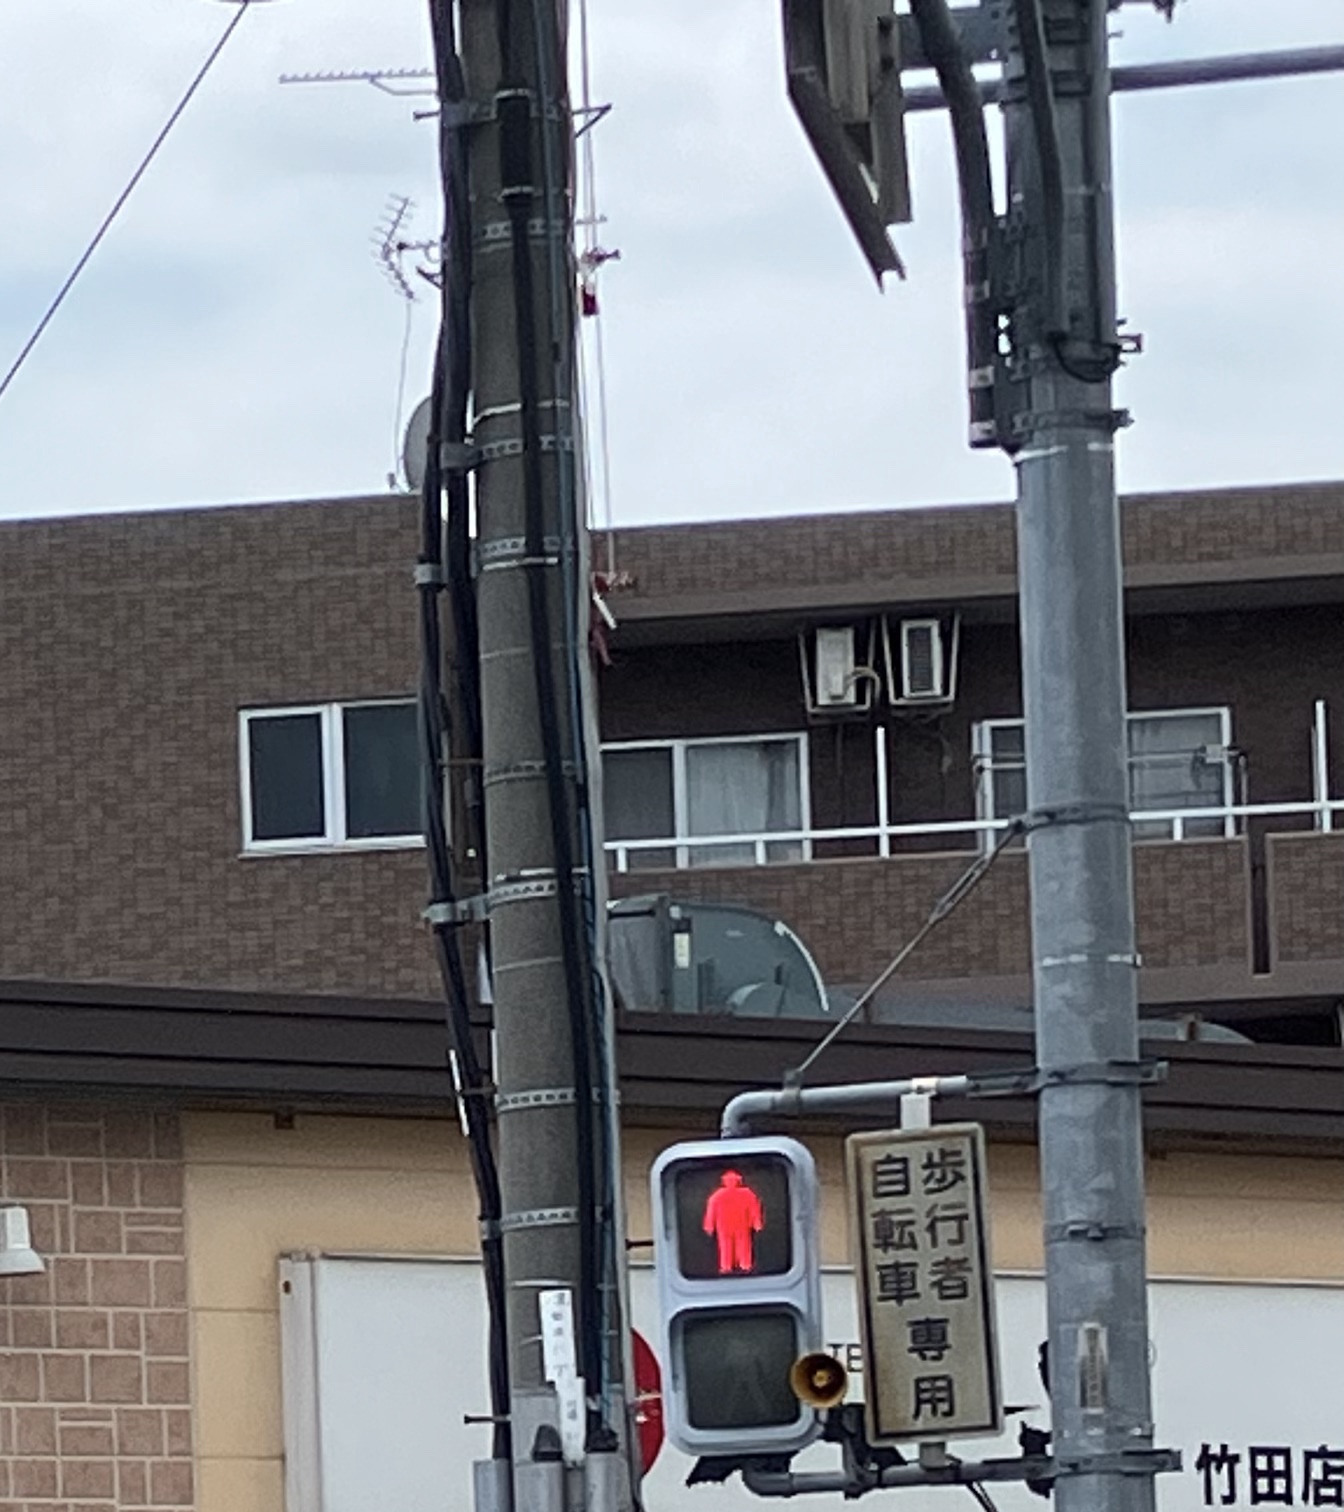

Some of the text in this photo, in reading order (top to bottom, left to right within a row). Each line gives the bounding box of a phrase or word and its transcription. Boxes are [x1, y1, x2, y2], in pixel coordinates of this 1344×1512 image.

[870, 1153, 921, 1306] 自転車
[921, 1148, 973, 1301] 歩行者
[906, 1316, 955, 1421] 専用
[1195, 1443, 1344, 1508] 竹田店
